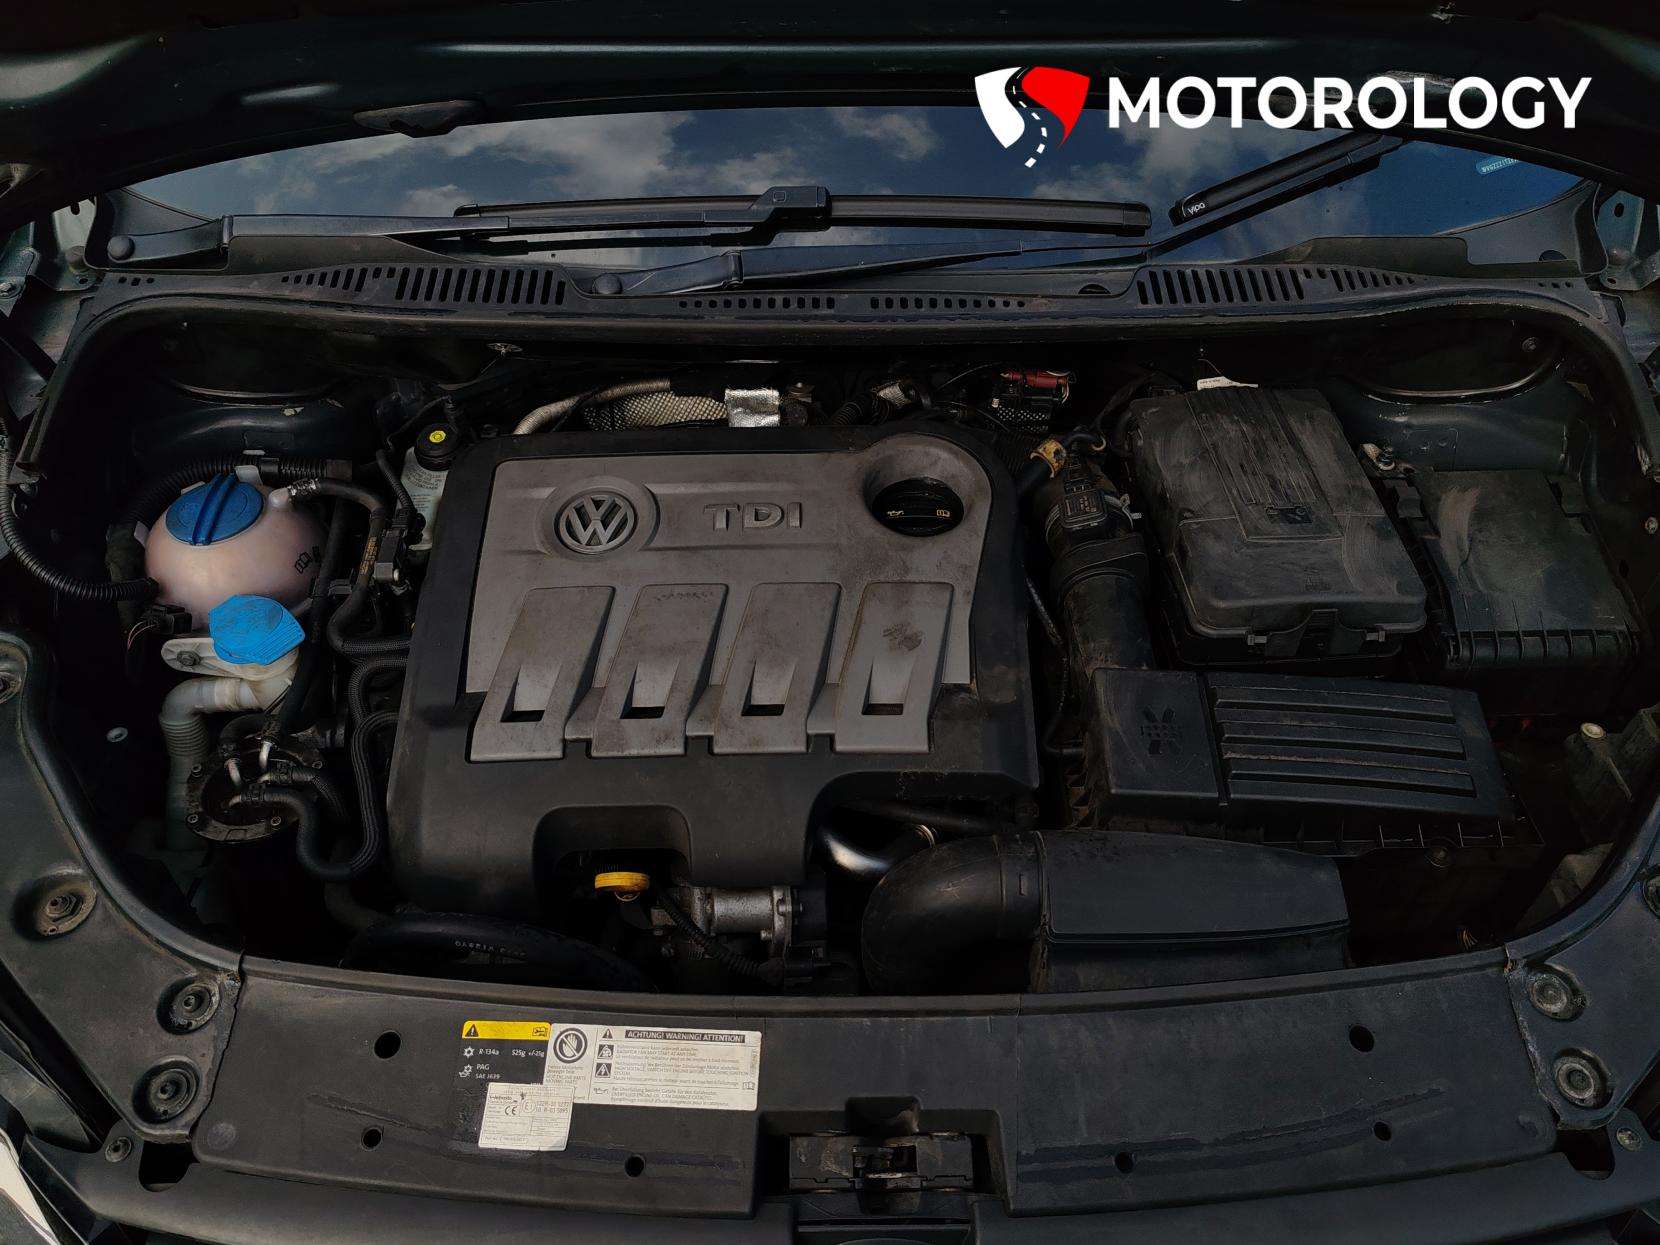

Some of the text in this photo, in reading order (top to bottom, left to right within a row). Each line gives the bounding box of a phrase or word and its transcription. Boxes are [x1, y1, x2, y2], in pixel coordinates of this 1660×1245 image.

[703, 502, 802, 533] TDI
[627, 1030, 744, 1043] ACHTUNG! WARNING! ATTENTION!
[511, 1049, 526, 1058] 525g
